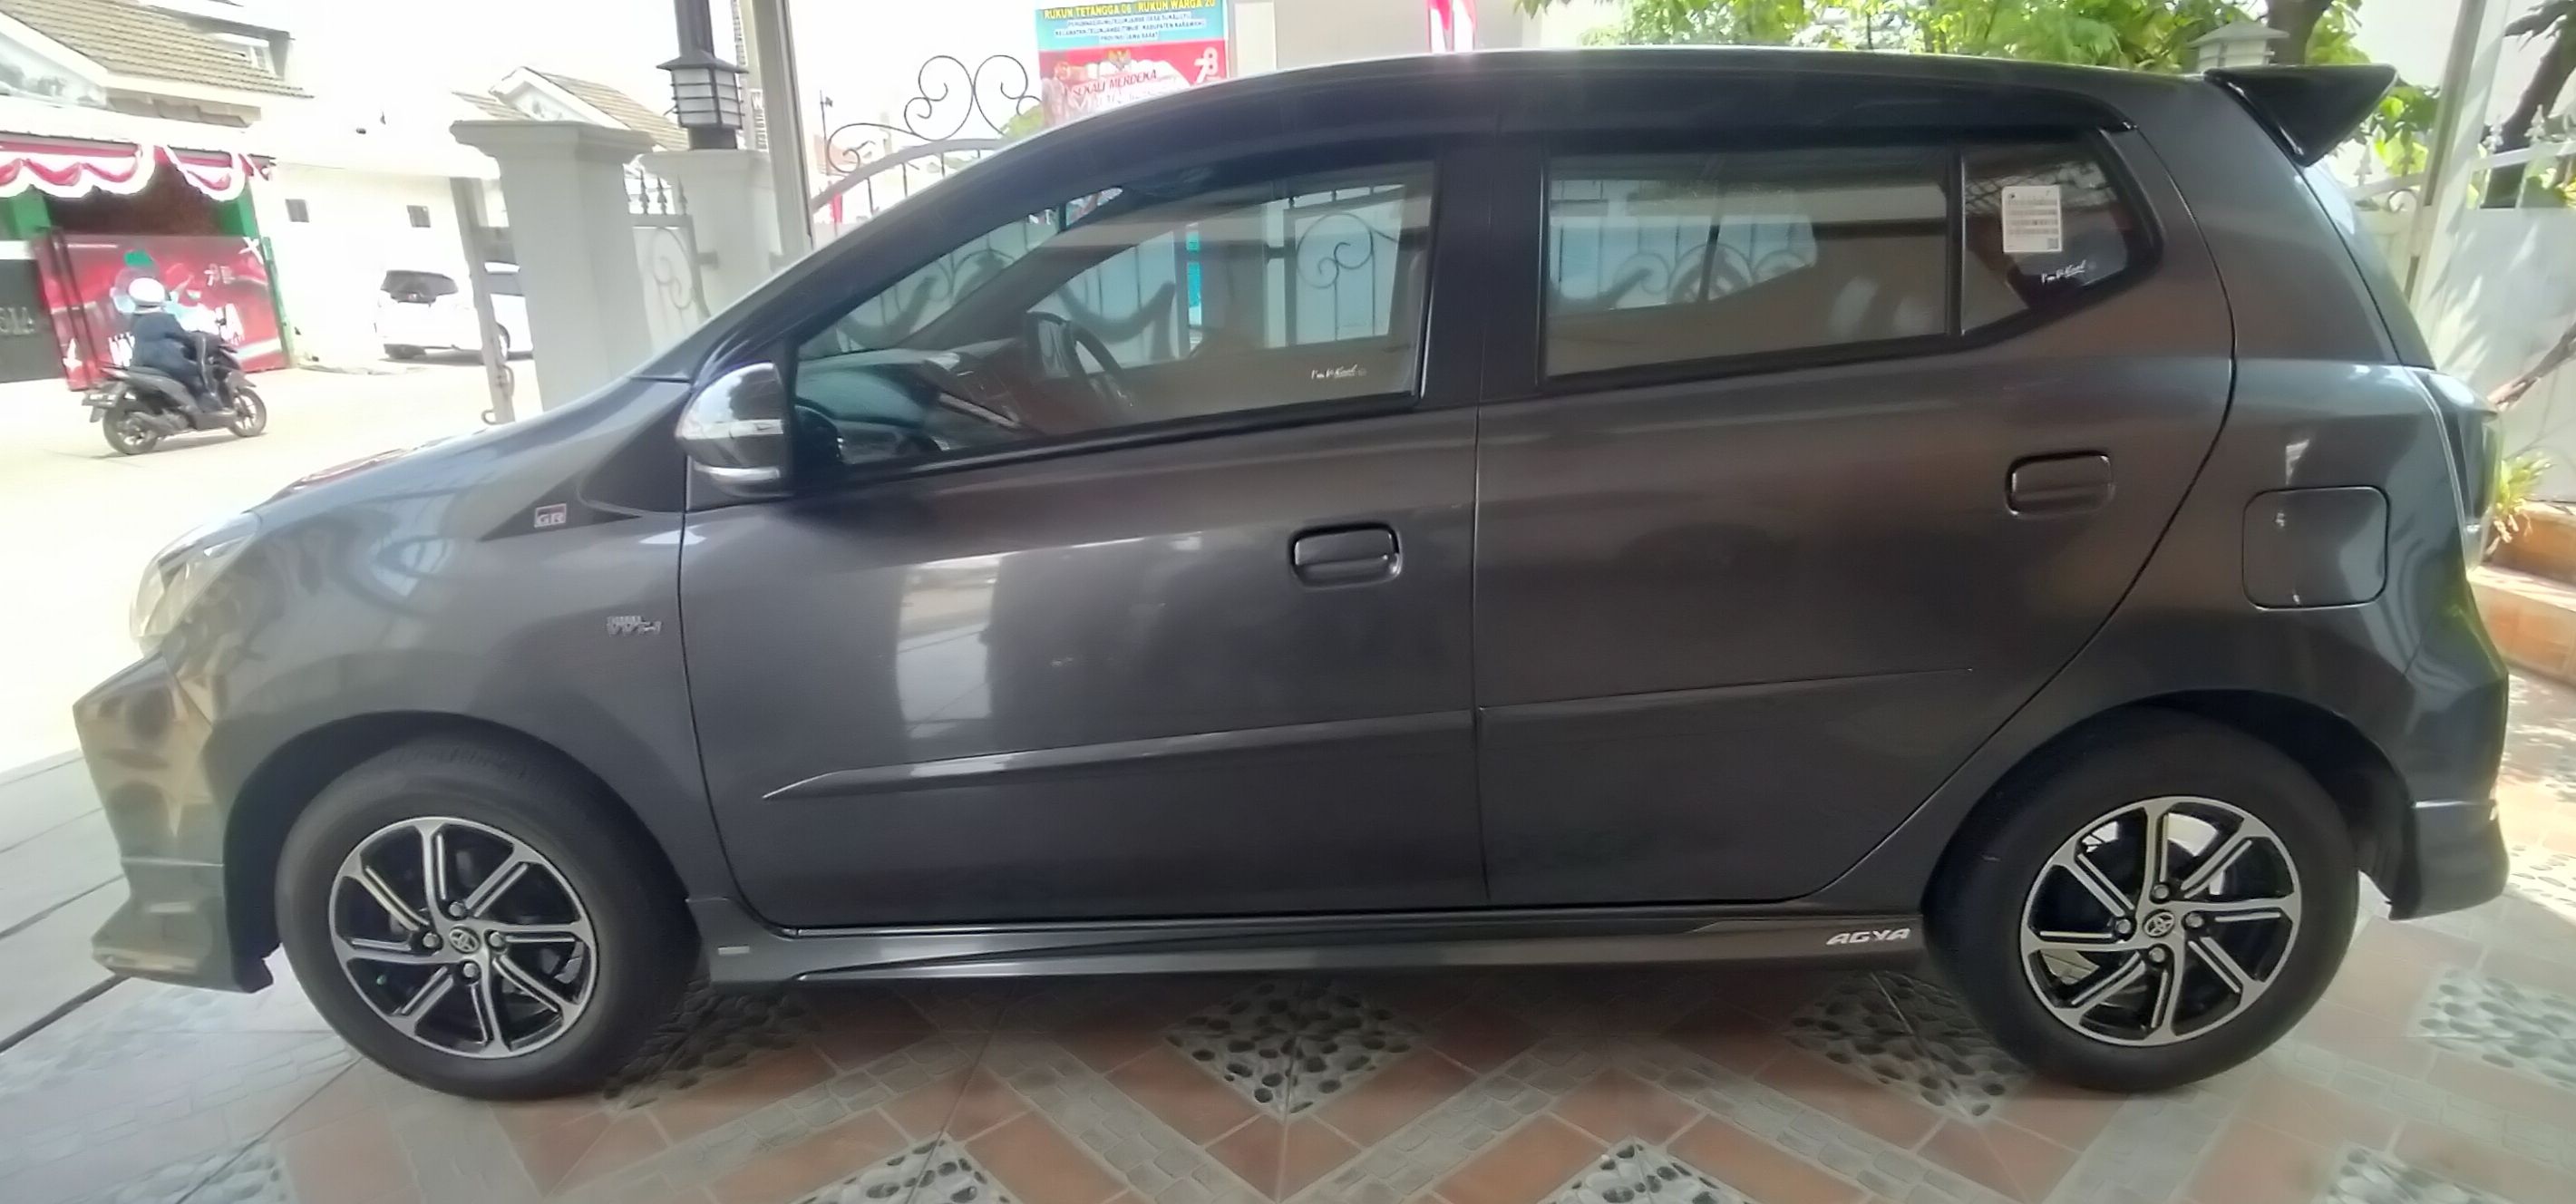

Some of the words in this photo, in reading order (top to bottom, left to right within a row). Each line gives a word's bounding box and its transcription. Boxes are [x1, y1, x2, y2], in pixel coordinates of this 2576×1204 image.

[1045, 7, 1074, 19] RUKUN
[1075, 5, 1119, 17] TETANGGA
[1139, 1, 1169, 13] RUKUN
[1826, 927, 1910, 945] AGYA
